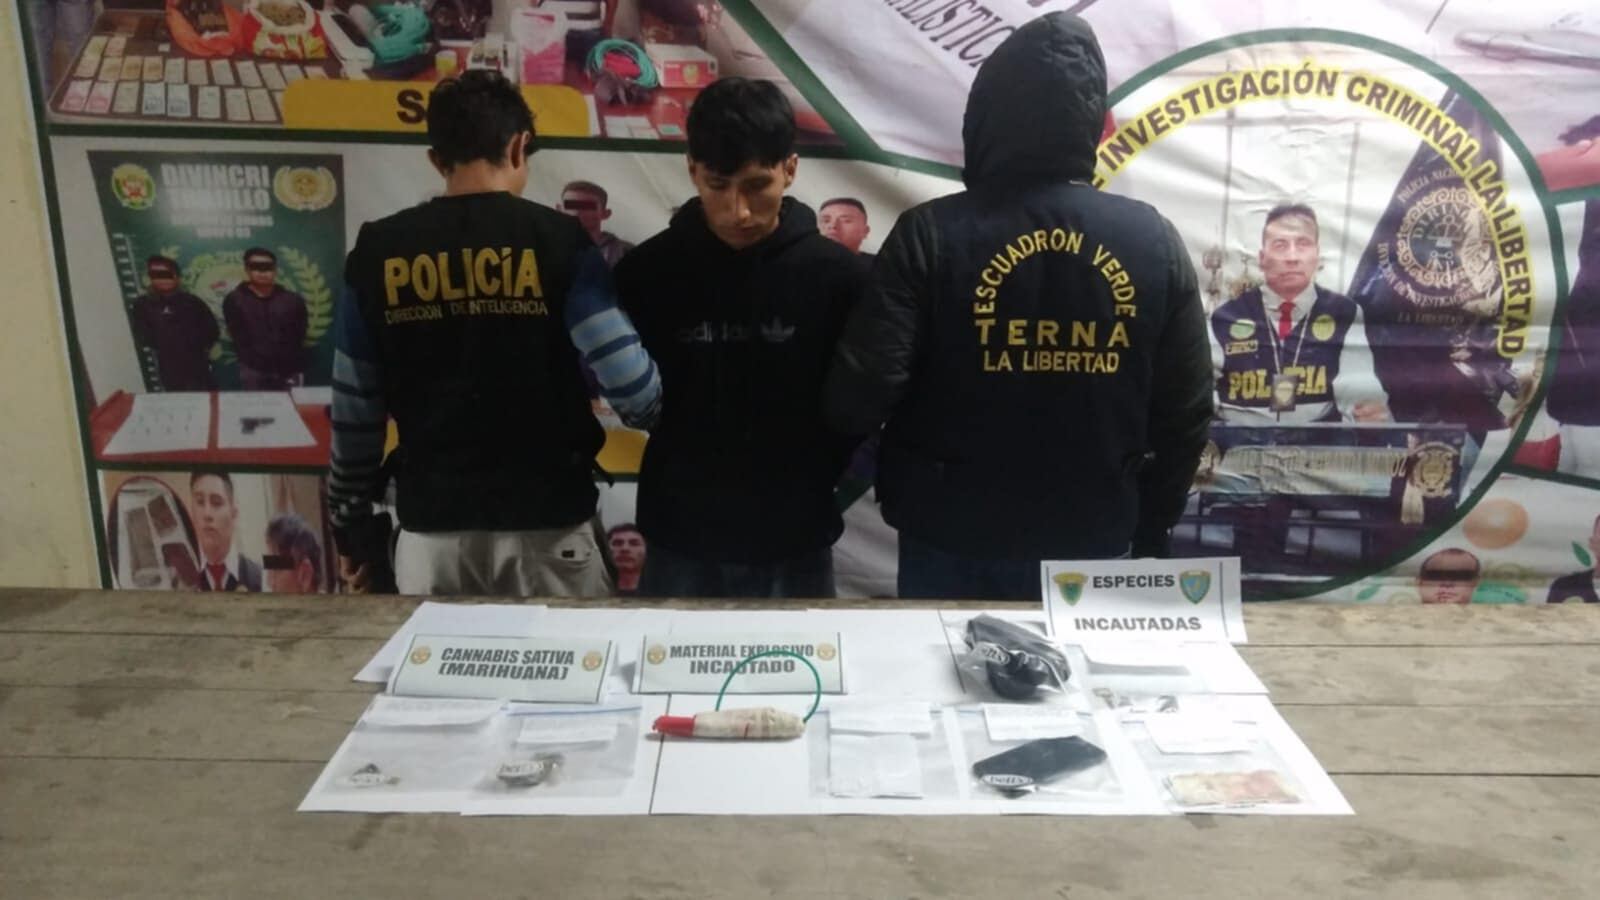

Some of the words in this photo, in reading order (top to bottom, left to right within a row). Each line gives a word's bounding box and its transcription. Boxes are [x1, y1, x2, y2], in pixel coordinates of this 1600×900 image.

[160, 162, 270, 188] DIVINCRI
[1099, 62, 1339, 172] INVESTIGACIÓN
[1346, 76, 1479, 171] CRIMINAL
[1493, 208, 1531, 355] LIBERTAD
[384, 247, 543, 306] POLICÍA
[973, 228, 1085, 314] ESCUADRON
[1092, 244, 1137, 318] VERDE
[469, 300, 549, 316] INTELIGENCIA
[974, 318, 1131, 348] TERNA
[983, 350, 1013, 372] LA
[1022, 351, 1120, 374] LIBERTAD
[1092, 575, 1175, 588] ESPECIES
[1075, 617, 1203, 631] INCAUTADAS
[440, 648, 519, 664] CANNABIS
[521, 650, 575, 665] SATIVA
[670, 645, 736, 659] MATERIAL
[740, 644, 814, 658] EXPLOSIVO
[689, 660, 796, 675] INCAUTADO
